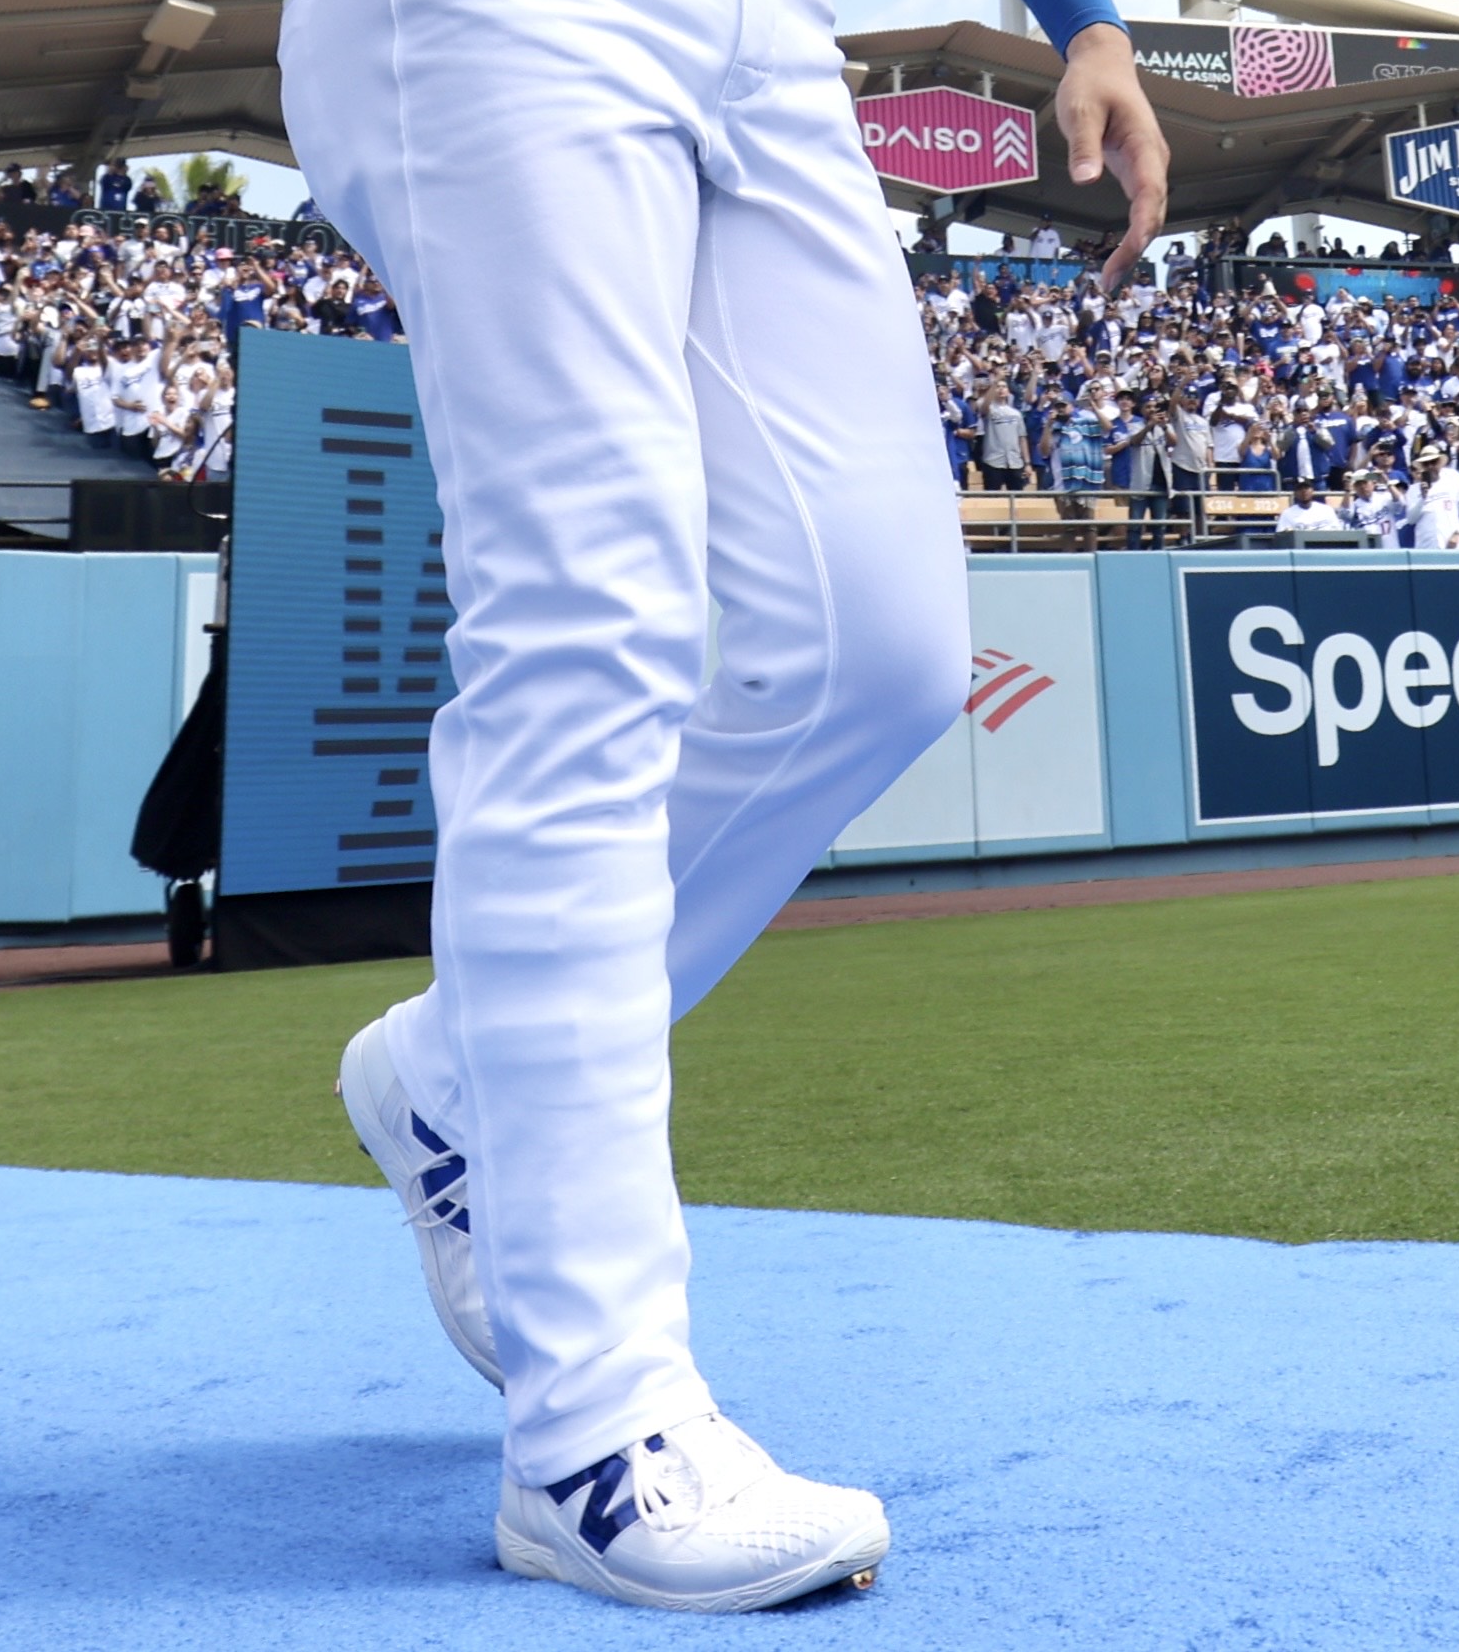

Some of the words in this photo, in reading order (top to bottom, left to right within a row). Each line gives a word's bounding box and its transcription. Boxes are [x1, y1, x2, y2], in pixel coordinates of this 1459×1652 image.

[1133, 49, 1229, 71] AAMAVA'
[1183, 70, 1232, 84] CASINO
[863, 122, 982, 153] DAISO
[1399, 139, 1452, 195] JIM
